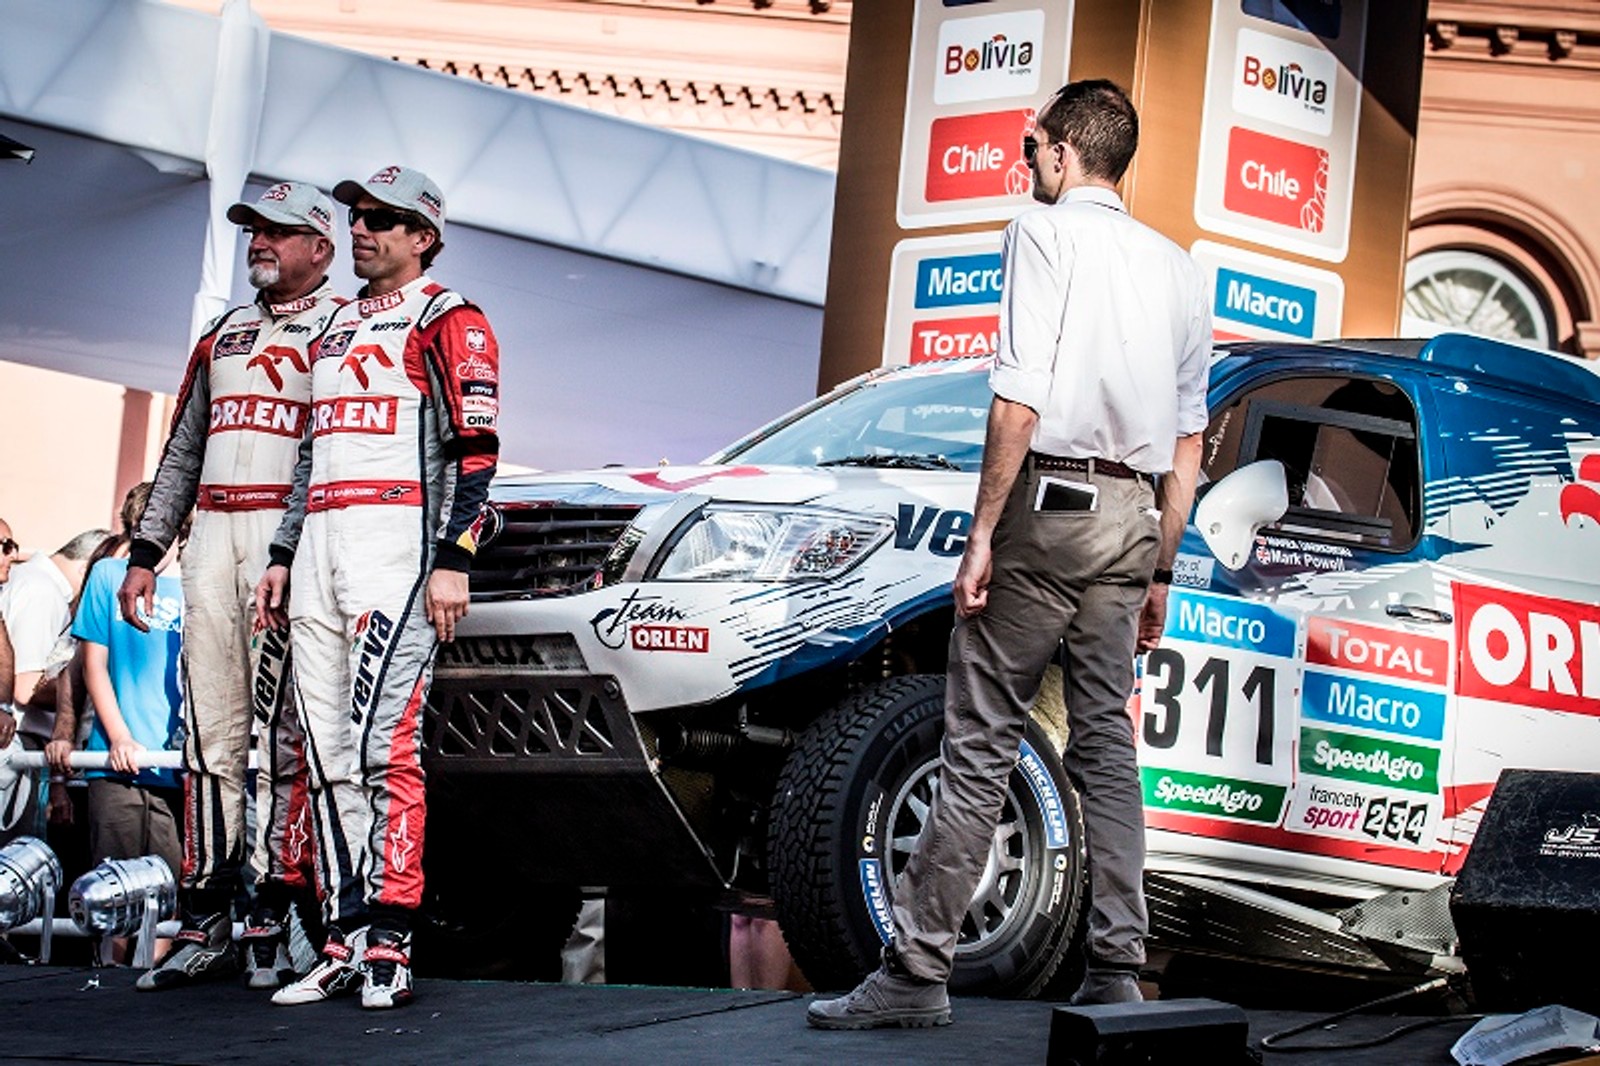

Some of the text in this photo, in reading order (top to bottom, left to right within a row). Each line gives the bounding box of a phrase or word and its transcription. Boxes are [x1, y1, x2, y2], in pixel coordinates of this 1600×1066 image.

[942, 142, 1004, 175] Chile
[1240, 159, 1301, 200] Chile
[1226, 280, 1303, 324] Macro
[635, 630, 705, 650] ORLEN
[1179, 600, 1266, 644] Macro
[350, 610, 394, 725] verva
[1324, 626, 1435, 678] TOTAL
[1143, 648, 1276, 766] 311
[1327, 682, 1421, 729] Macro
[1313, 740, 1425, 781] SpeedAgro
[1023, 754, 1065, 843] MICHELIN
[1154, 777, 1262, 813] SpeedAgro
[1303, 806, 1360, 831] sport
